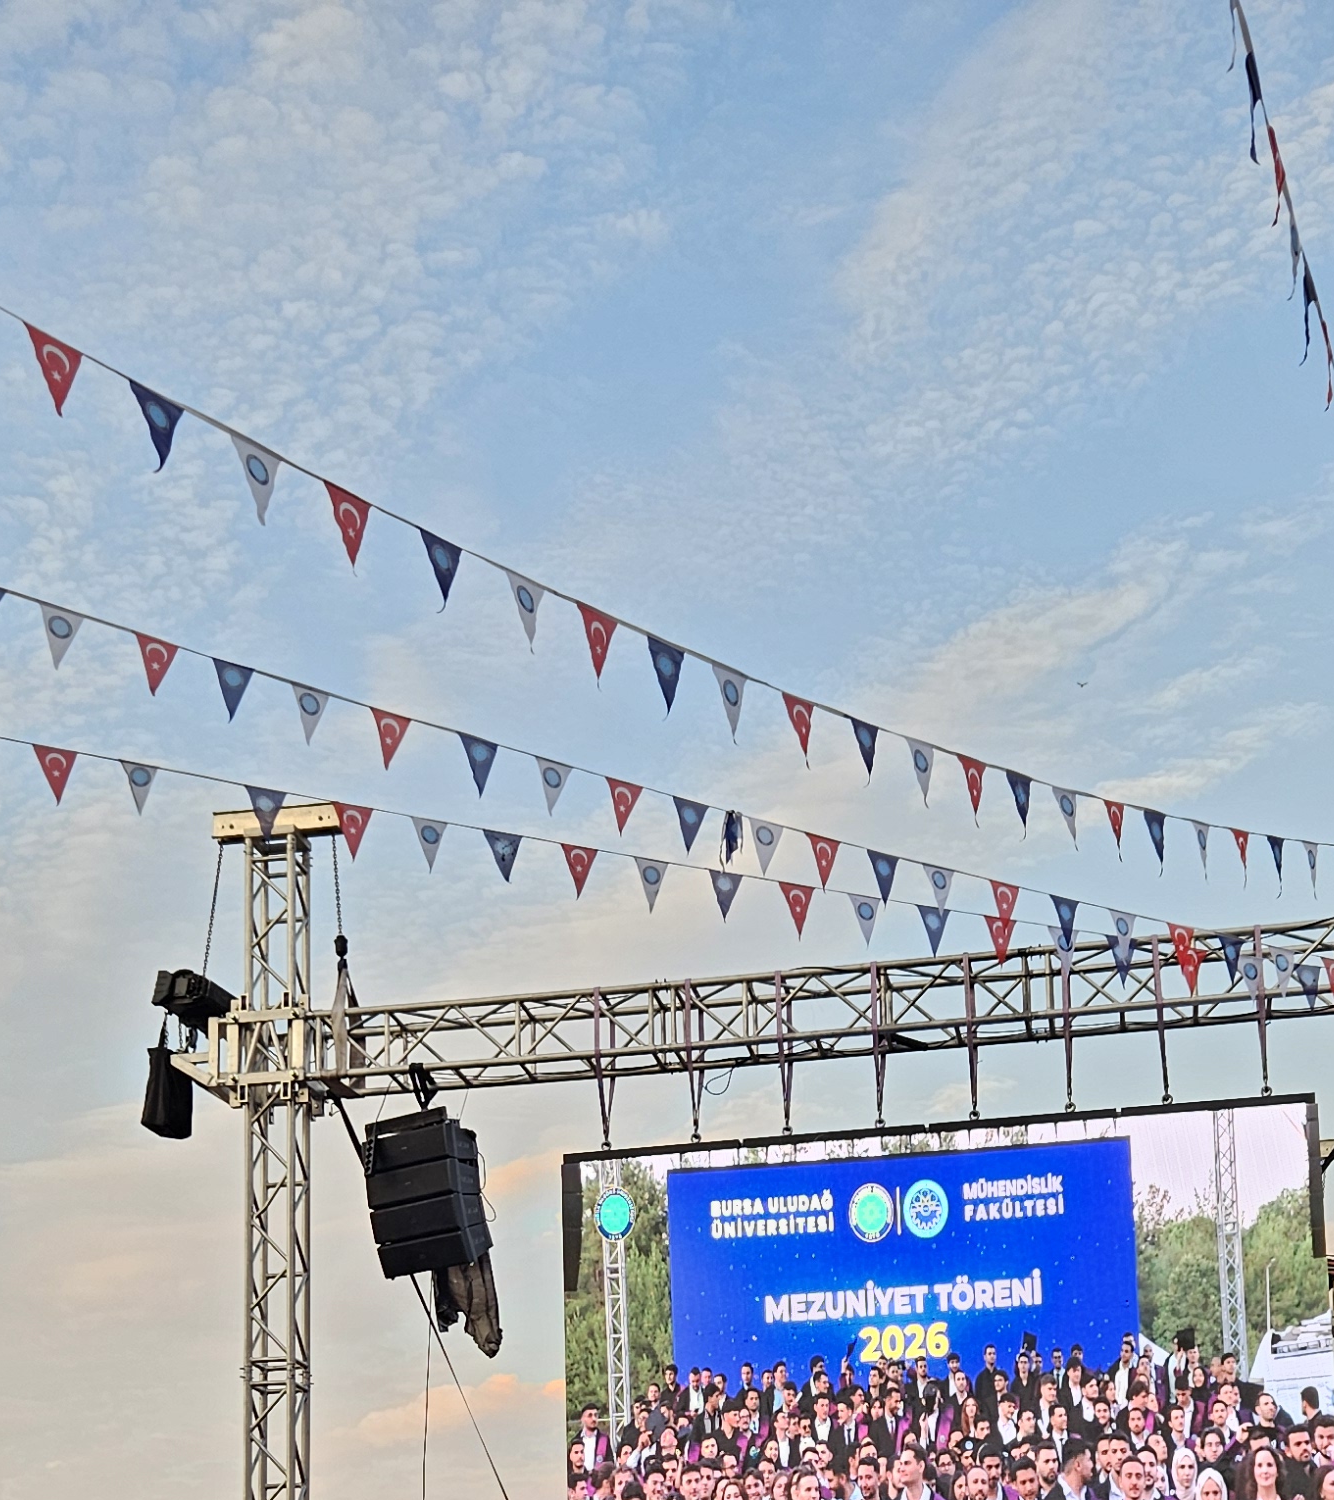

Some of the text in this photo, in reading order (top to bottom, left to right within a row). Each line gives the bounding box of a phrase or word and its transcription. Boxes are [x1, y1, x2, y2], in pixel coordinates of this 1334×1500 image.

[962, 1172, 1064, 1200] MÜHENDİSLİK
[710, 1189, 834, 1218] BURSA ULUDAĞ
[964, 1193, 1065, 1223] FAKÜLTESİ
[711, 1211, 835, 1239] ÜNİVERSİTESİ
[765, 1268, 1042, 1323] MEZUNİYET TÖRENİ
[858, 1321, 949, 1363] 2026
